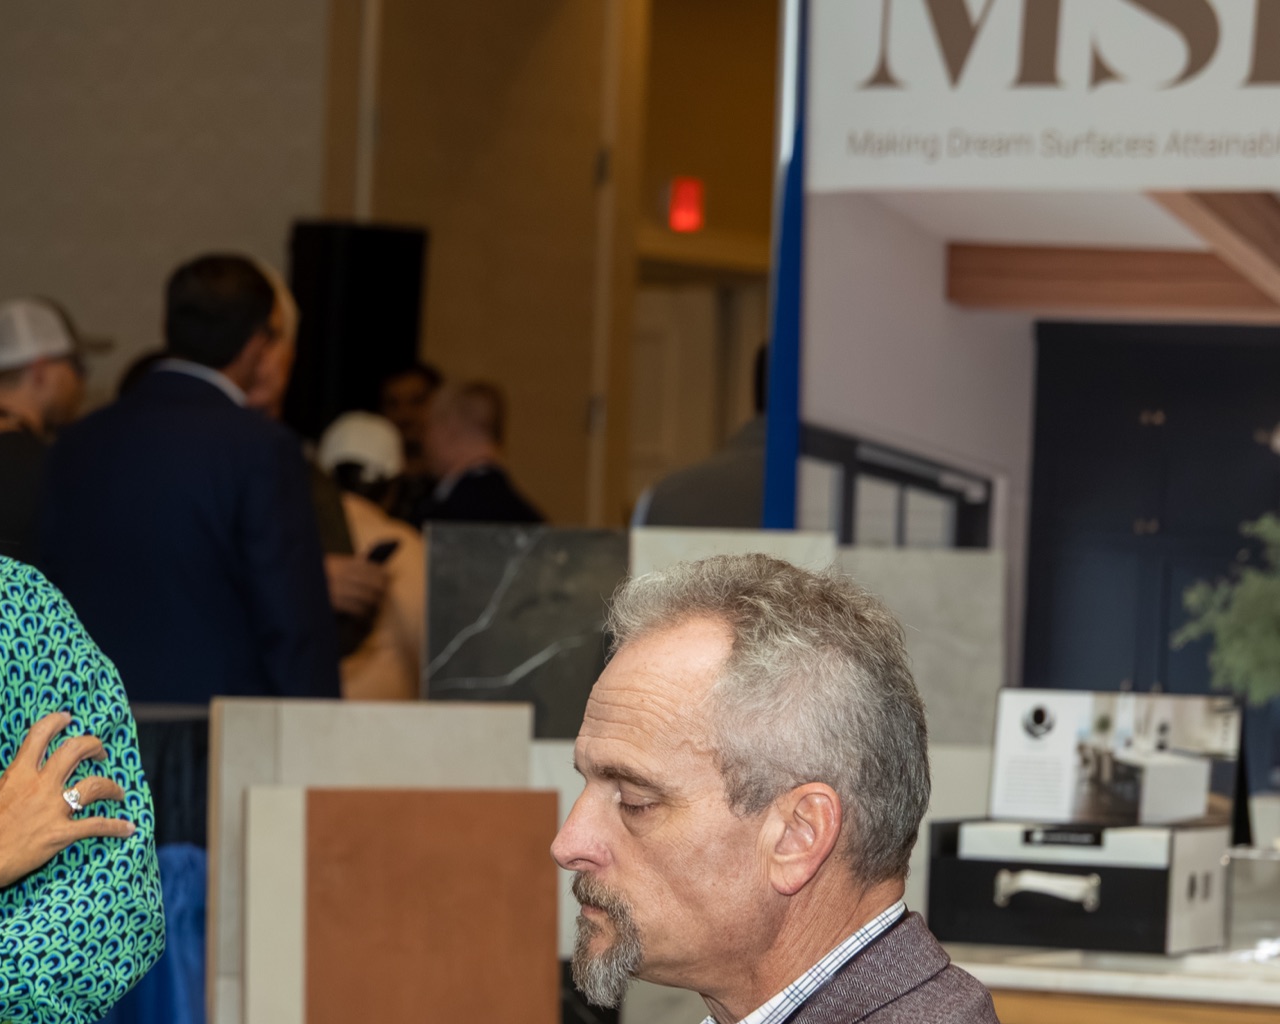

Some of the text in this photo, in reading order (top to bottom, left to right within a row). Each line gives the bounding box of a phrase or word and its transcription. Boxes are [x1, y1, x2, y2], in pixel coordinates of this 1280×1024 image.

[847, 129, 939, 165] Making
[947, 127, 1034, 158] Dream
[1040, 127, 1157, 158] Surfaces
